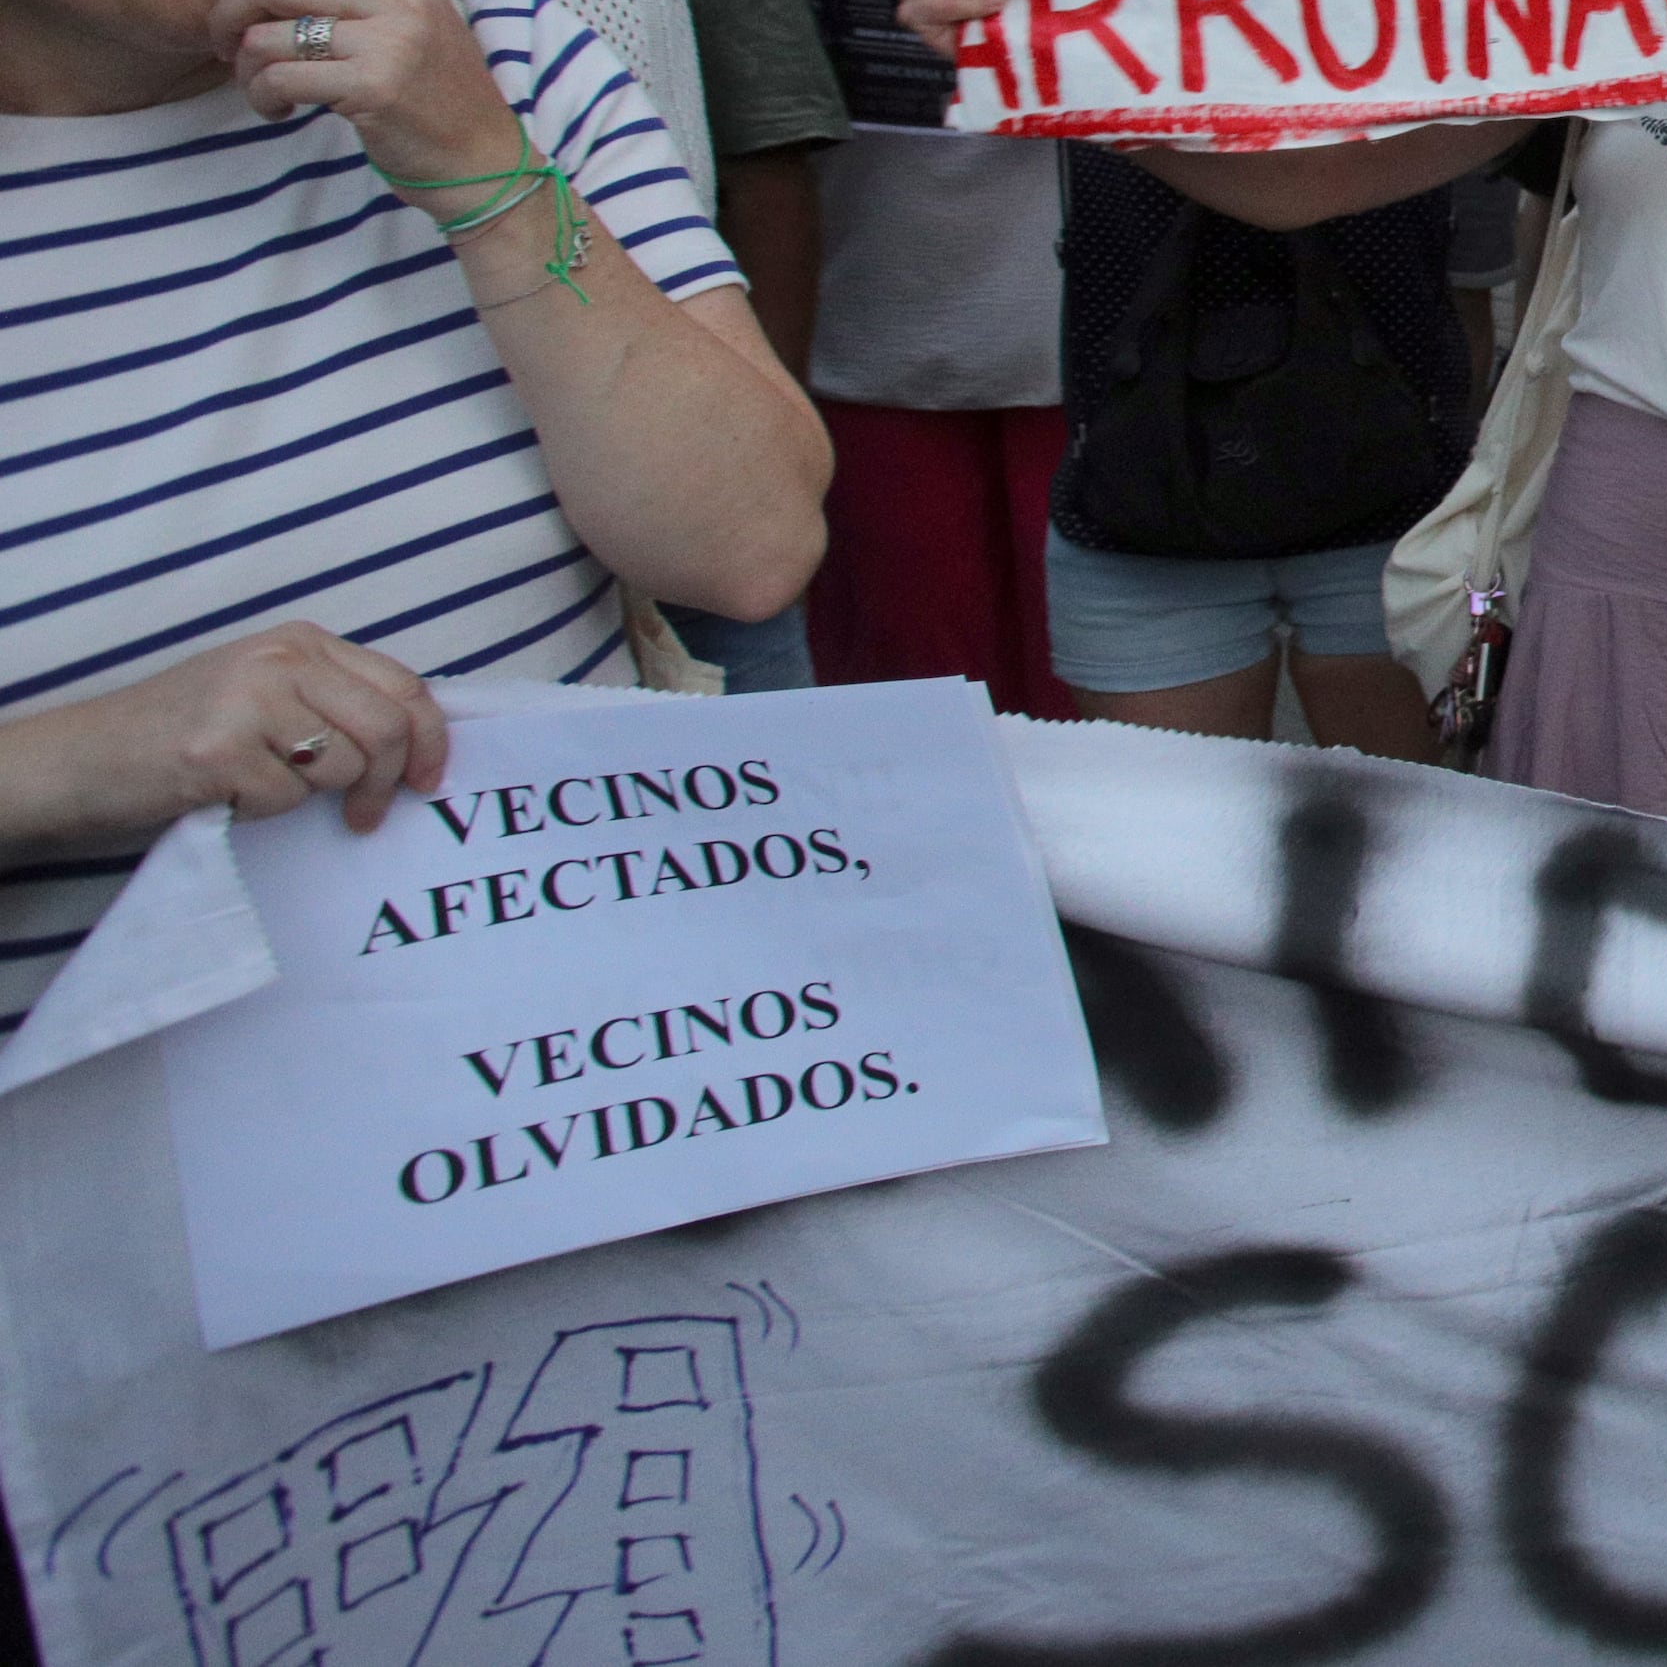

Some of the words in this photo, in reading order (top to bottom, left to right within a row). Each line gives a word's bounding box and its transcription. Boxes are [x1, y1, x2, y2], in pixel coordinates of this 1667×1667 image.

[427, 756, 782, 847] VECINOS
[357, 825, 873, 956] AFECTADOS,
[461, 978, 843, 1100] VECINOS
[397, 1047, 922, 1205] OLVIDADOS.
